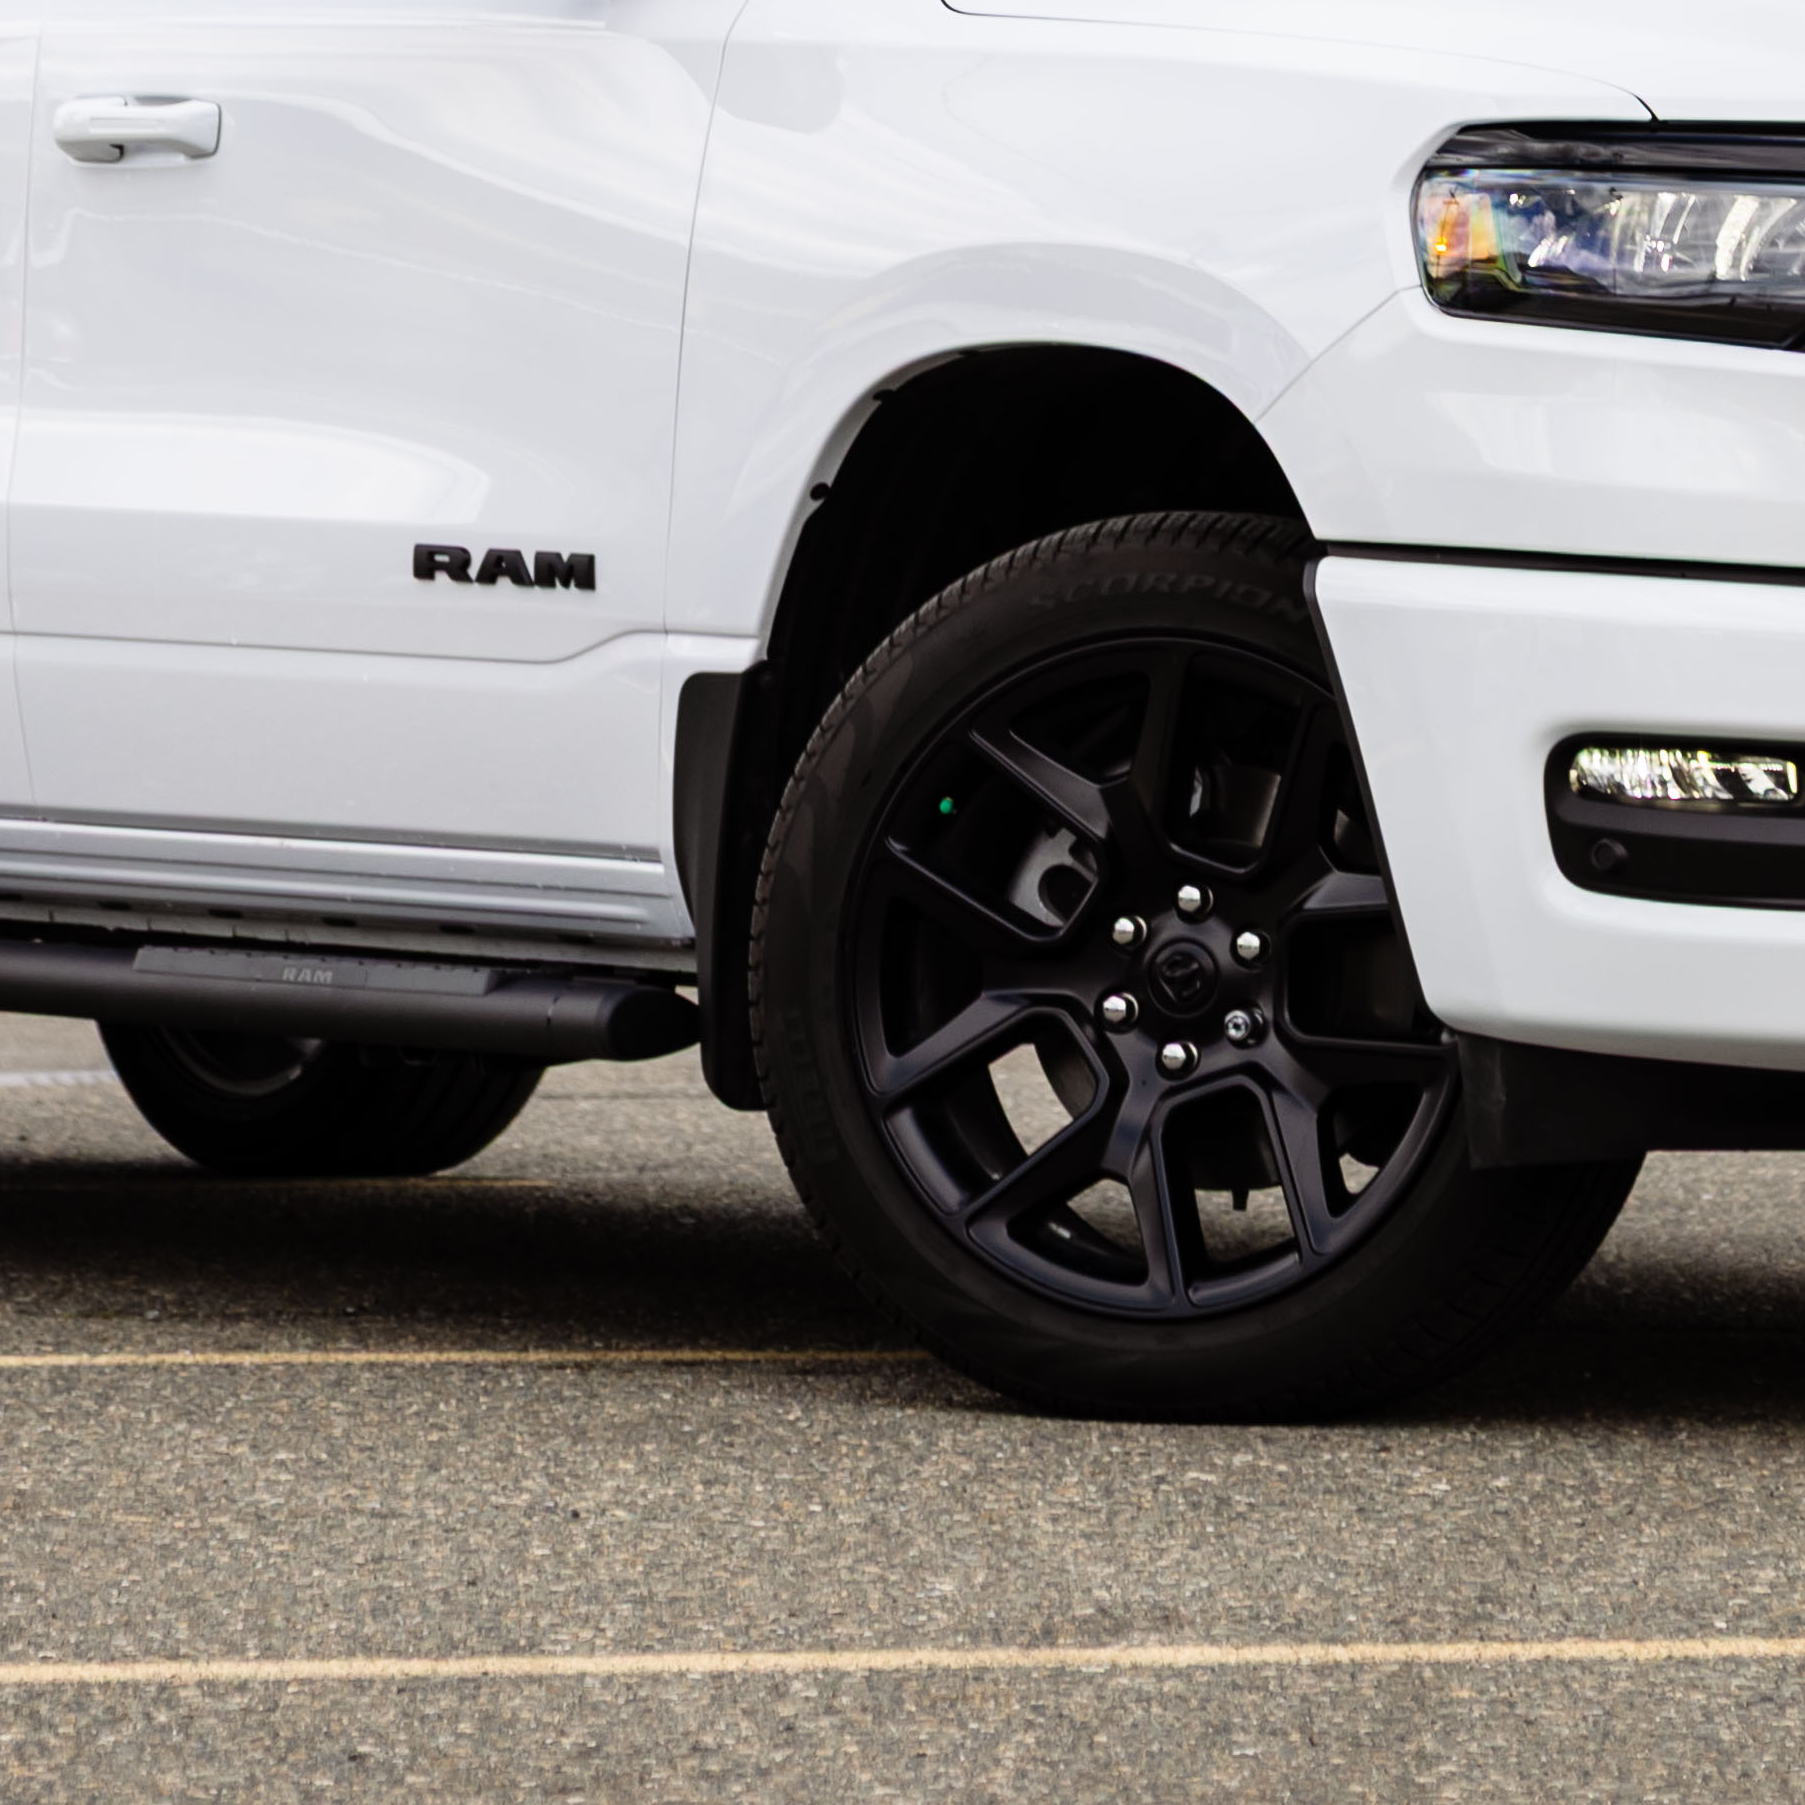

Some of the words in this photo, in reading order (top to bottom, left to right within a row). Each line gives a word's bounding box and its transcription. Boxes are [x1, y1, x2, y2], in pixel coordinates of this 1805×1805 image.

[412, 542, 597, 592] RAM
[1028, 570, 1309, 625] SCORPION
[282, 967, 334, 985] RAM
